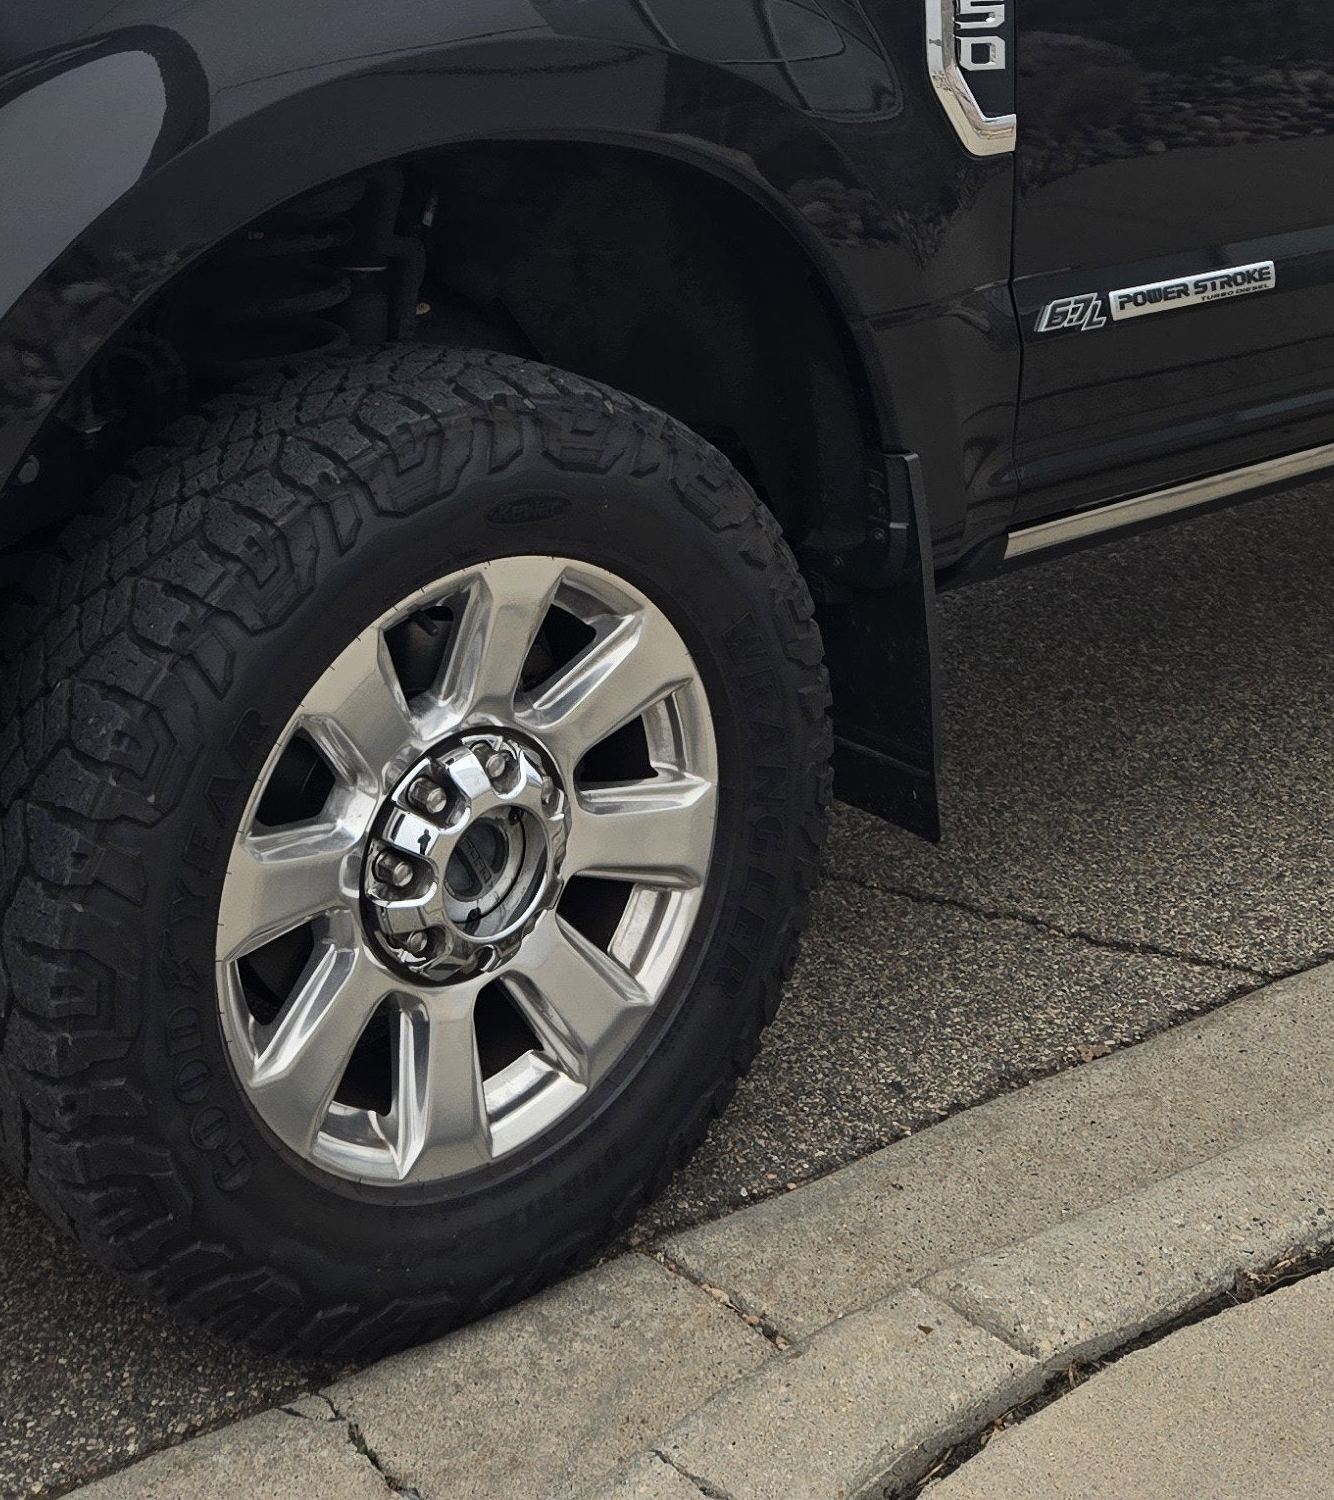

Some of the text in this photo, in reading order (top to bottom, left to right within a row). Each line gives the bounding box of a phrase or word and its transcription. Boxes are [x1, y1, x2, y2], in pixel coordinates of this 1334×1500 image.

[1035, 265, 1272, 332] 6.7L POWER STROKE
[1200, 283, 1271, 301] TURBO DIESEL
